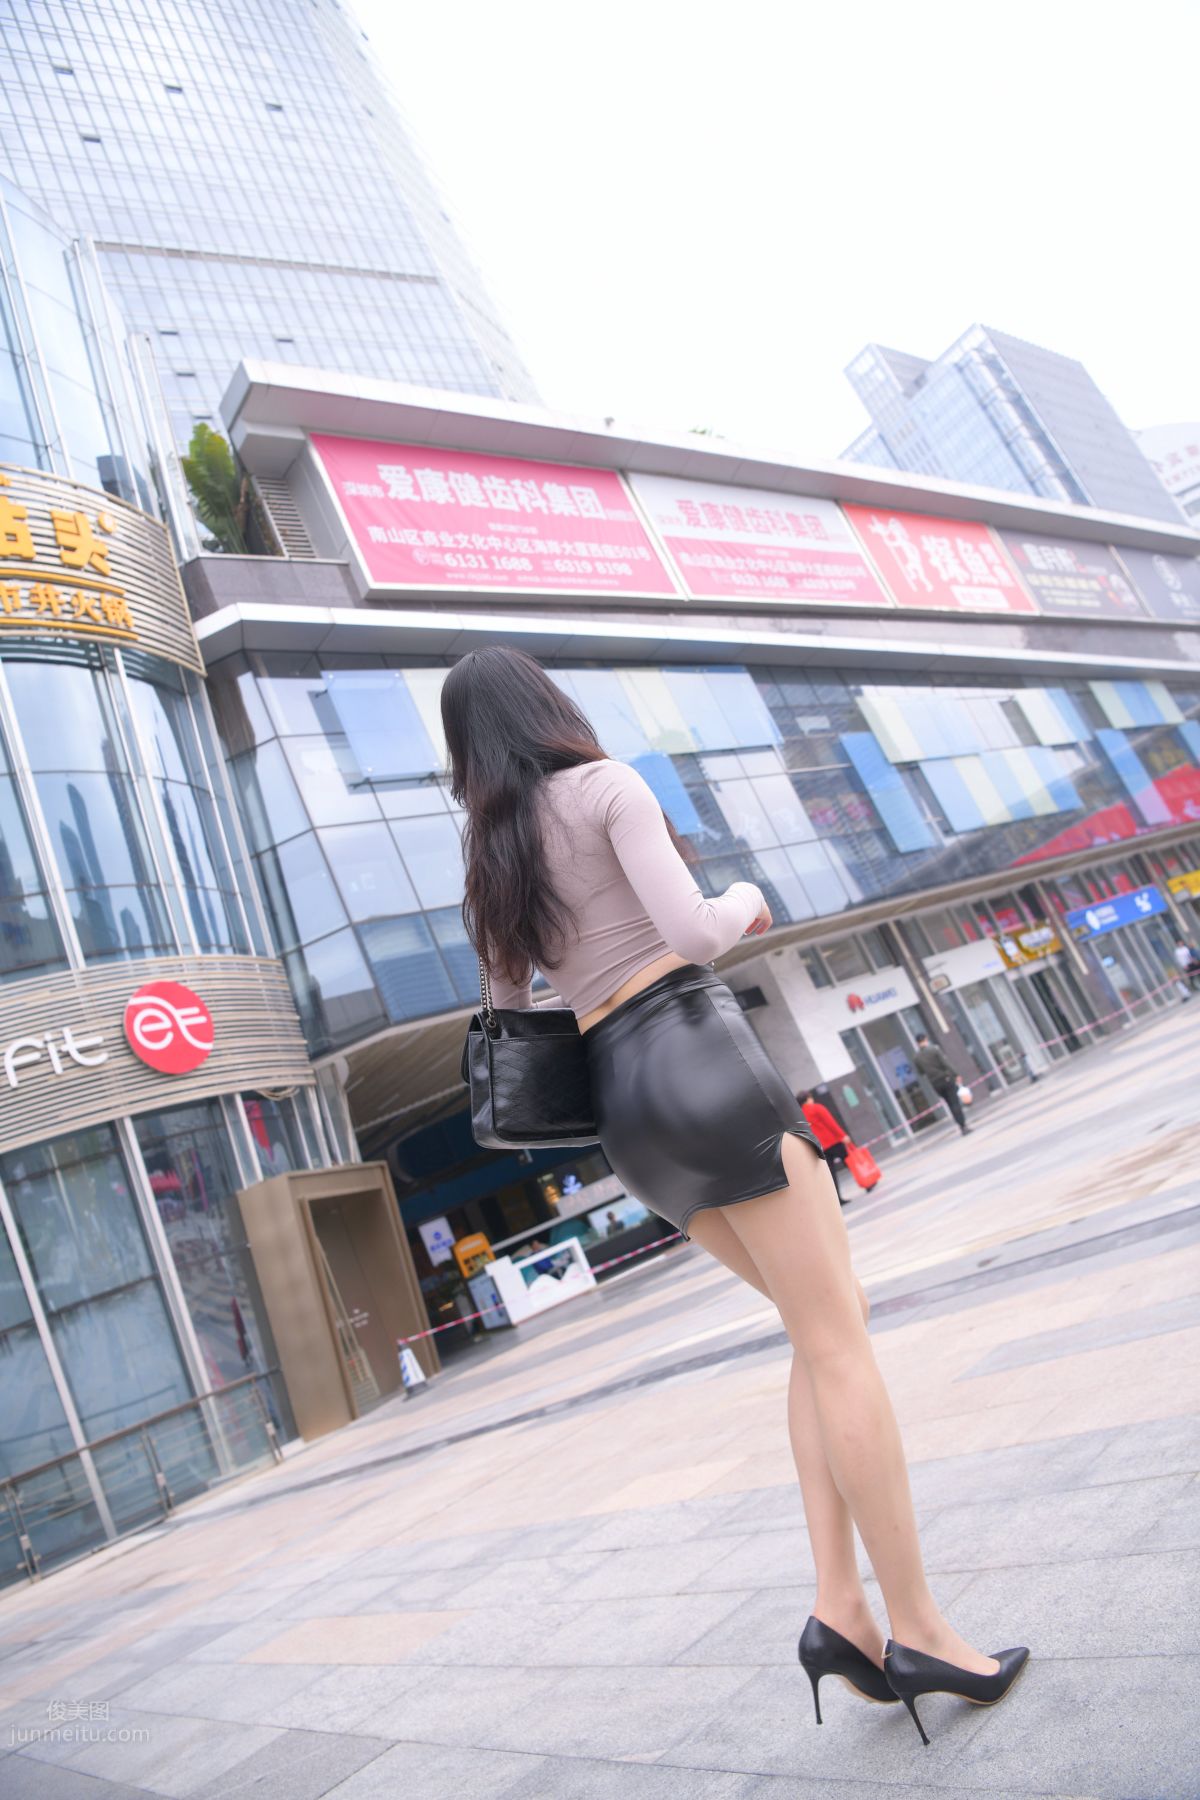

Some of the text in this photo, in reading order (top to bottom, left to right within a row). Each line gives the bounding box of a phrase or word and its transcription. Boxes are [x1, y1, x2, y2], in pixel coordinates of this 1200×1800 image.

[377, 464, 607, 520] 爱康健齿科集团
